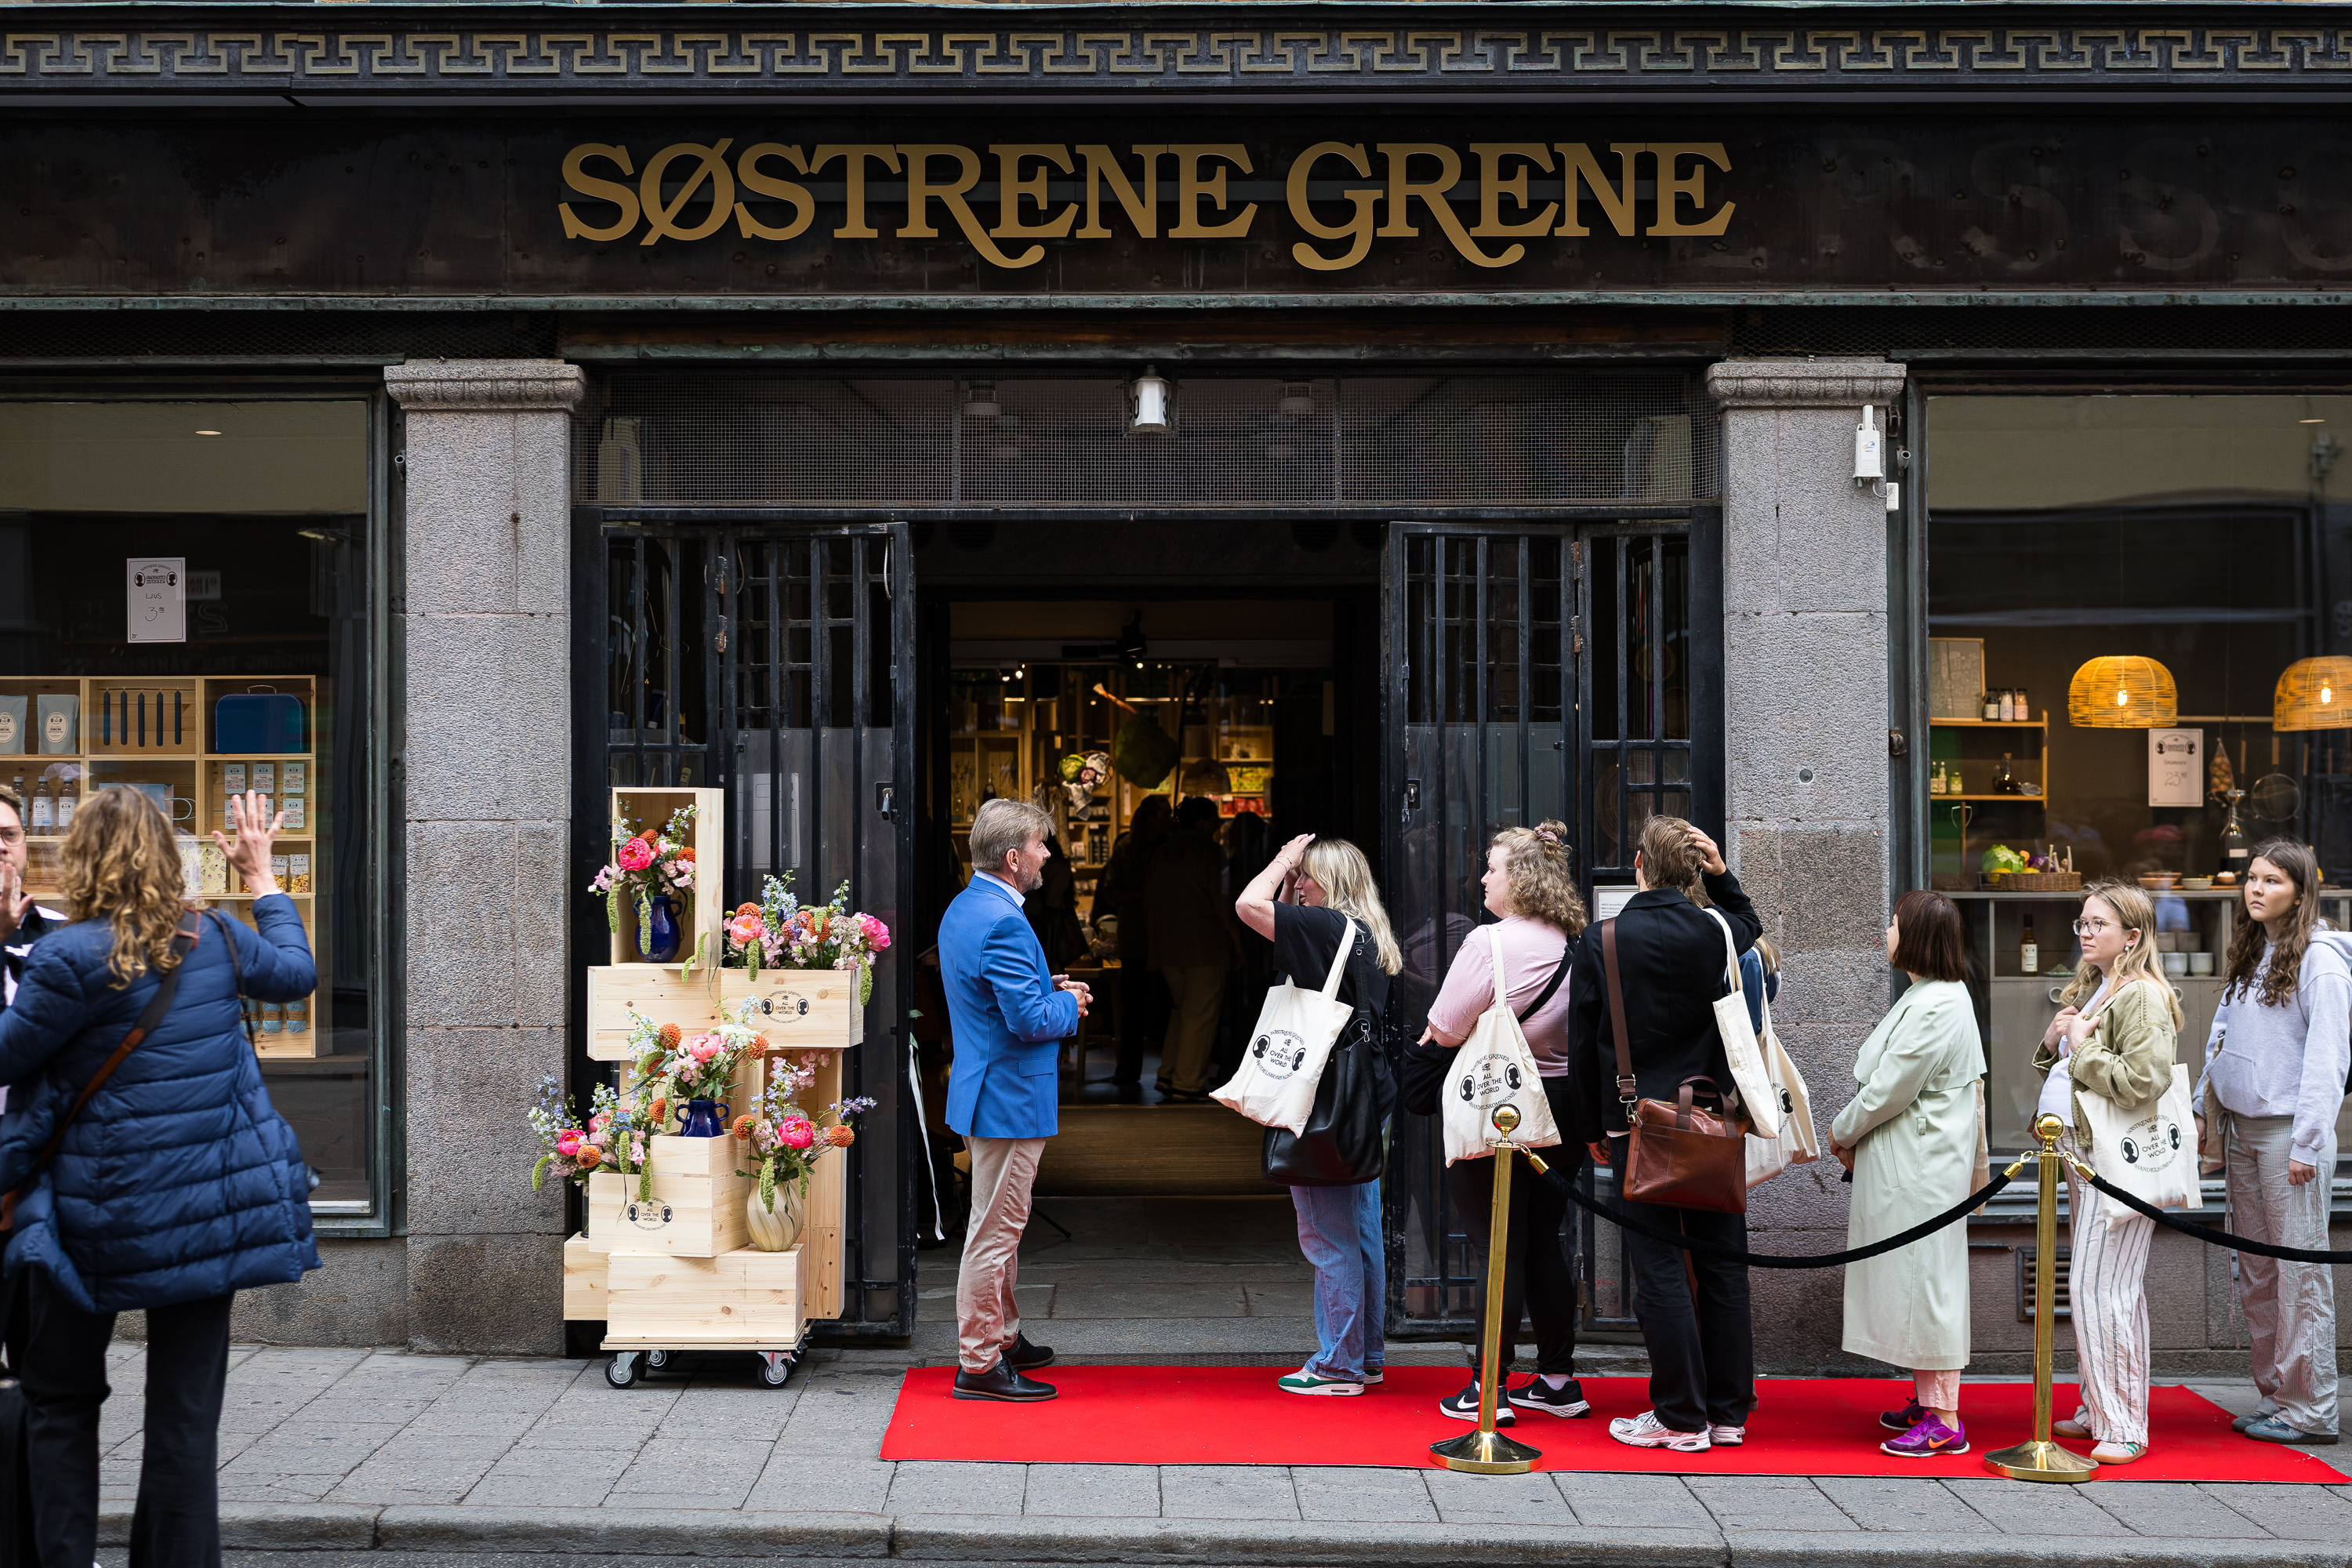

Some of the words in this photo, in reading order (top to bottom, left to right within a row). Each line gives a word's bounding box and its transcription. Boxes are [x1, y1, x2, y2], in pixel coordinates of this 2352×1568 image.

[559, 143, 1257, 268] SØSTRENE
[1287, 142, 1735, 270] GRENE
[1270, 1051, 1283, 1060] OVER
[1270, 1057, 1287, 1068] WORLD
[1479, 1086, 1499, 1096] WORLD
[2142, 1142, 2159, 1152] OVER
